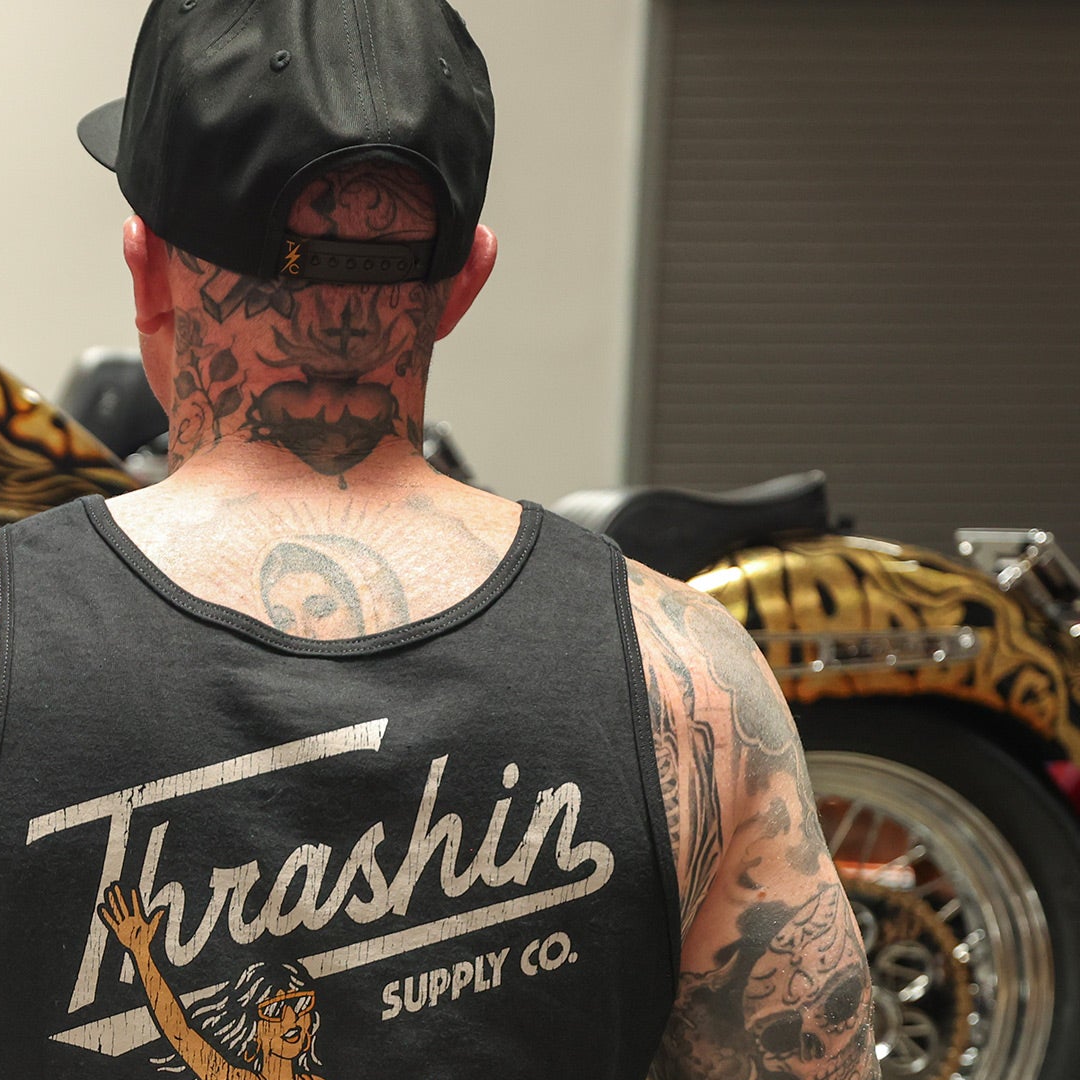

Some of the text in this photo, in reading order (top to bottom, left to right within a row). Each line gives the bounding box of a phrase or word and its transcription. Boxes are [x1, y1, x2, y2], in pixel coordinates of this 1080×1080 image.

[26, 718, 614, 1016] Thrashin
[381, 931, 579, 1021] SUPPLY CO.
